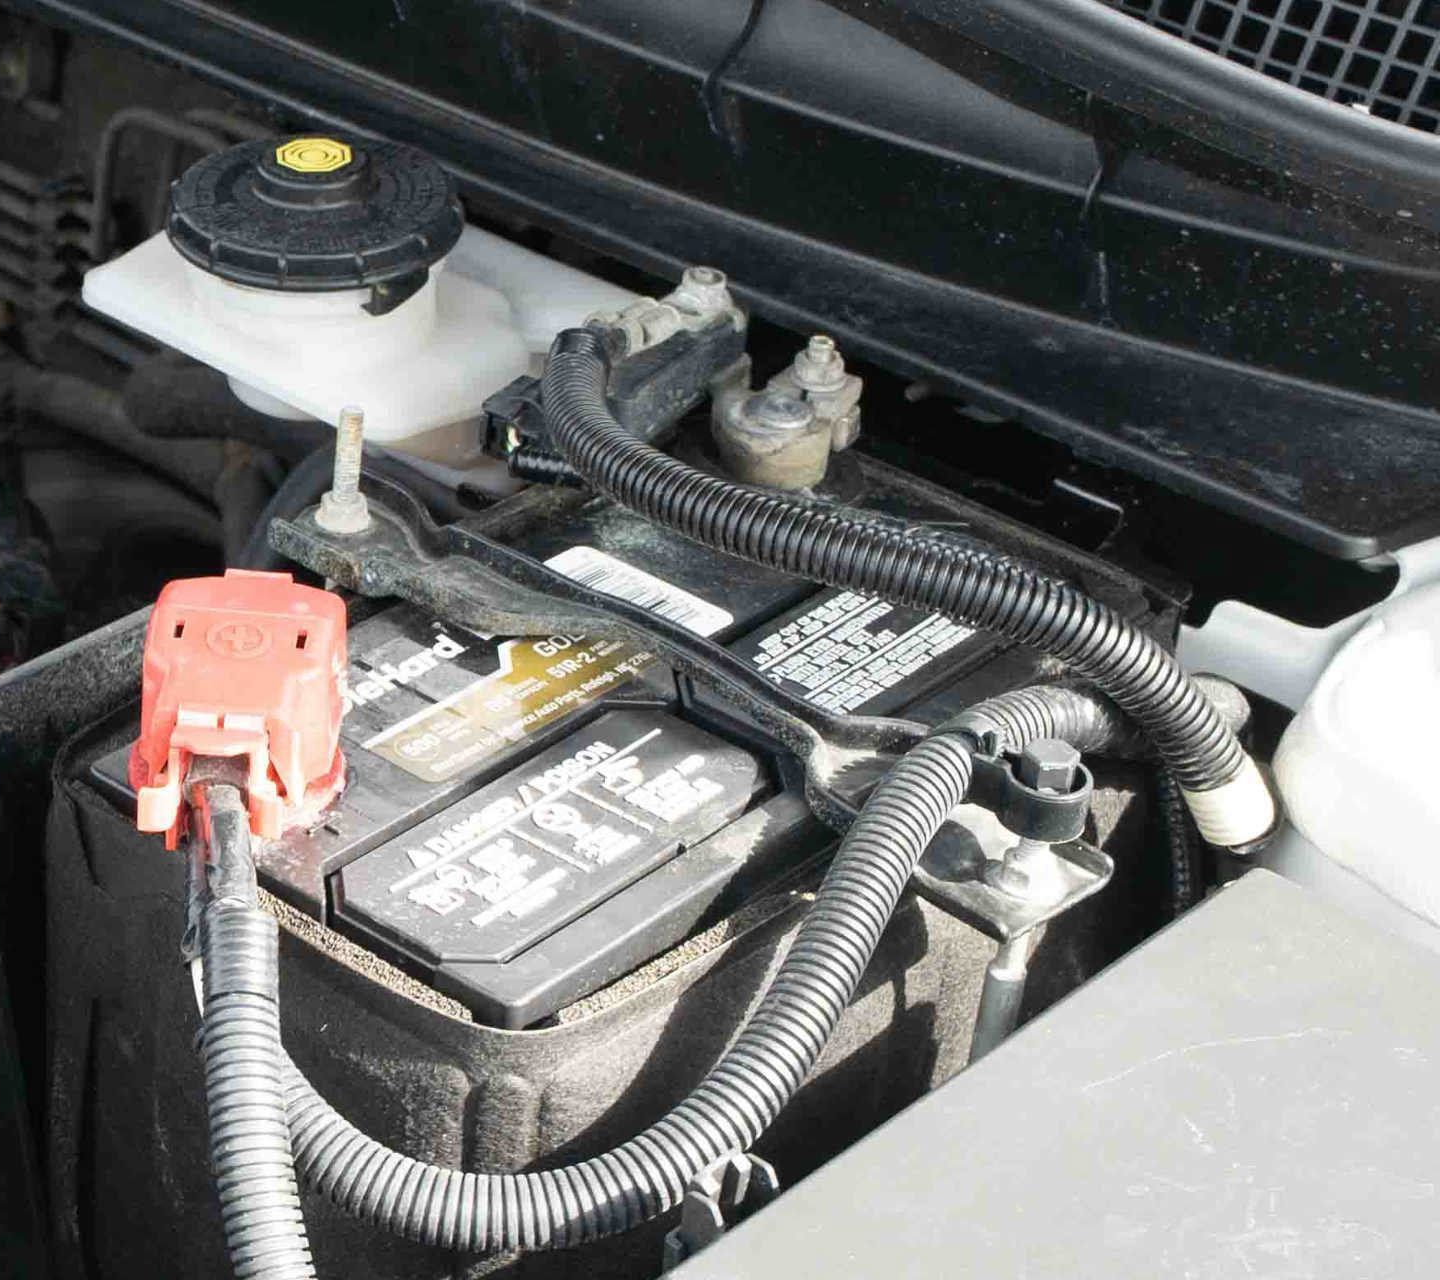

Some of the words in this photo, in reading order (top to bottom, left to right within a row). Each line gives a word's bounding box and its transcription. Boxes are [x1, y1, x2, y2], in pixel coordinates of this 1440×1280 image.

[534, 632, 586, 658] GOL
[341, 633, 466, 717] ieHard
[534, 740, 618, 794] POISON
